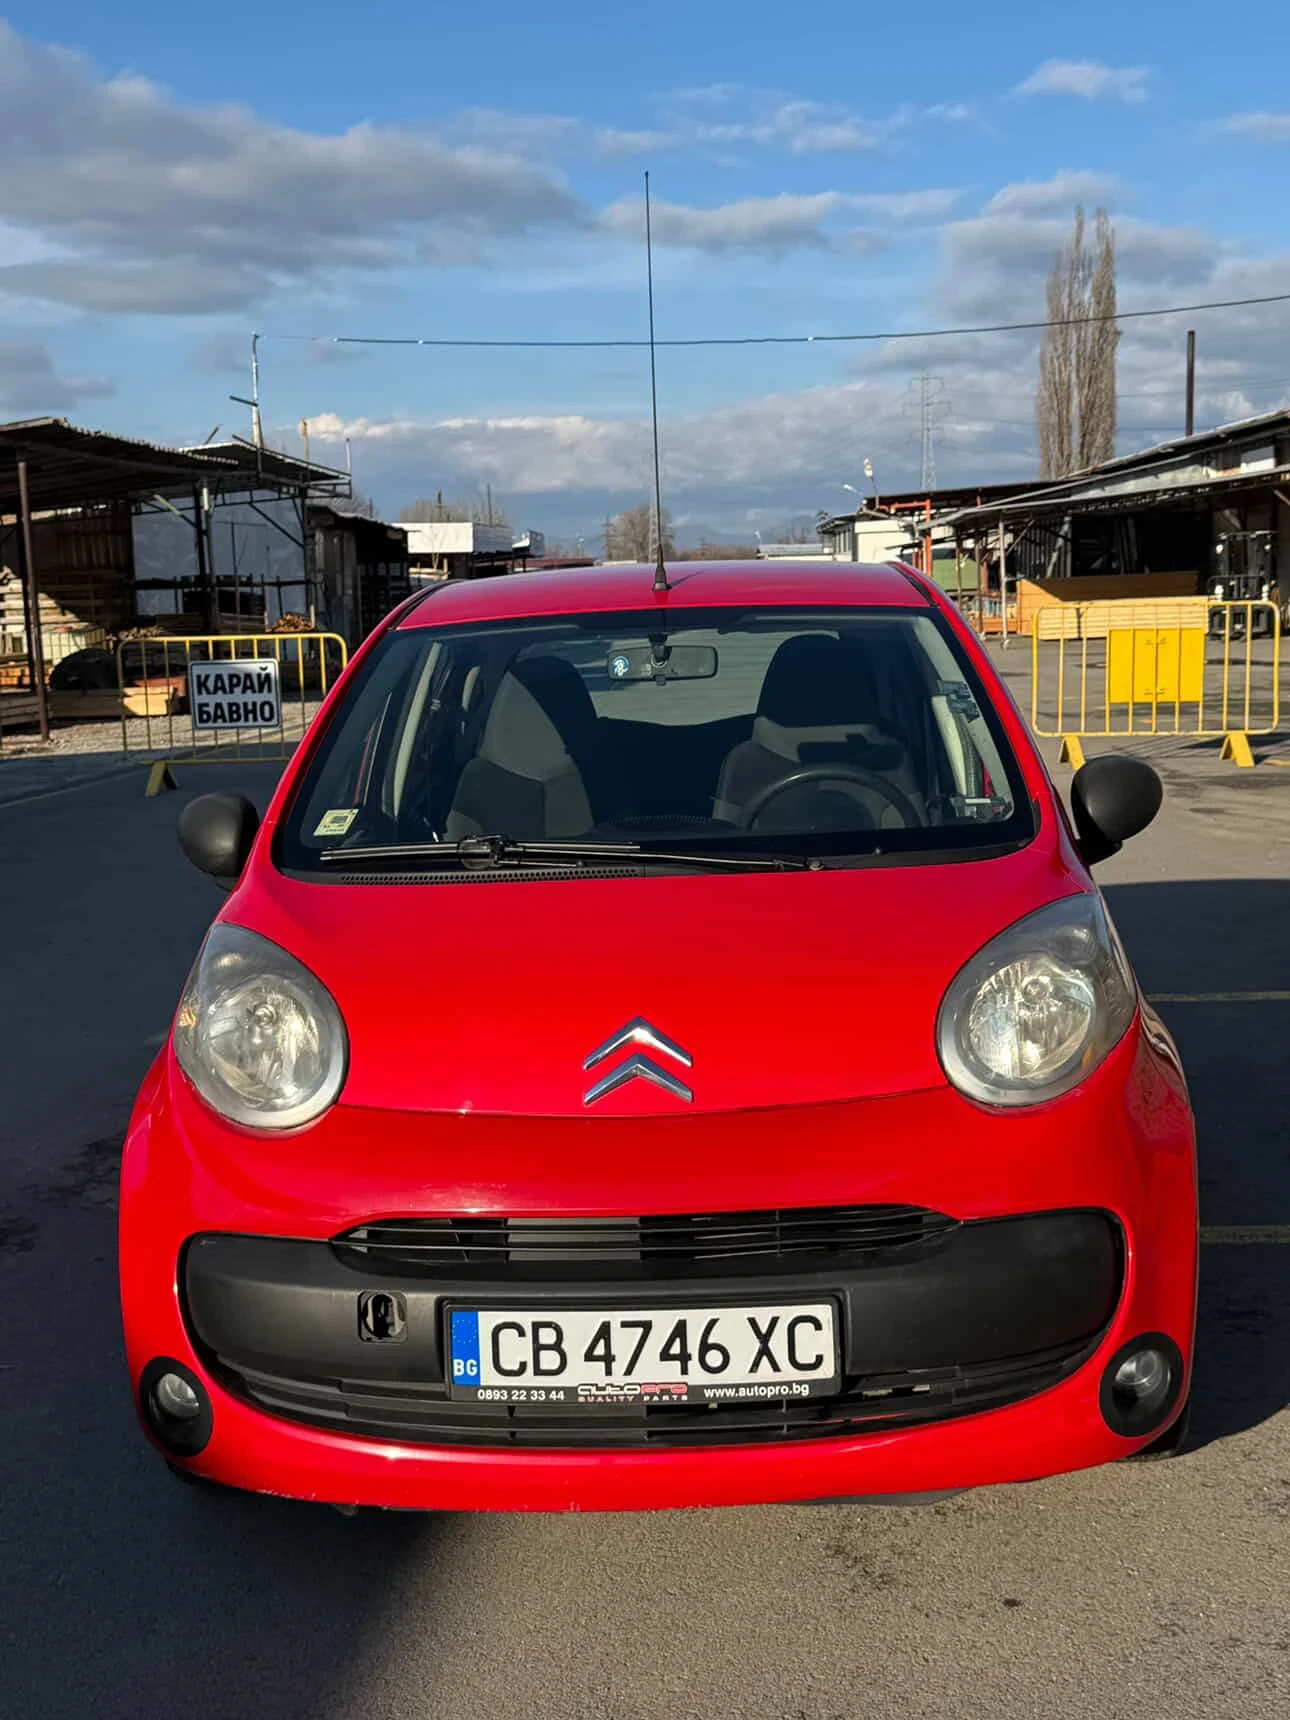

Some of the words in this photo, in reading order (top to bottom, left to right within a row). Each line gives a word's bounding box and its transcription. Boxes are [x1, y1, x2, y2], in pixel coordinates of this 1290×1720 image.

[196, 666, 273, 696] КАРАЙ
[197, 701, 275, 724] БАВНО
[491, 1320, 568, 1377] CB
[583, 1318, 731, 1377] 4746
[746, 1314, 824, 1373] XC
[453, 1359, 478, 1376] BG
[477, 1389, 508, 1400] 0893
[511, 1390, 527, 1400] 22
[530, 1390, 546, 1400] 33
[549, 1390, 565, 1400] 44
[577, 1395, 635, 1403] QUALITY
[703, 1383, 810, 1399] www.autopro.bg
